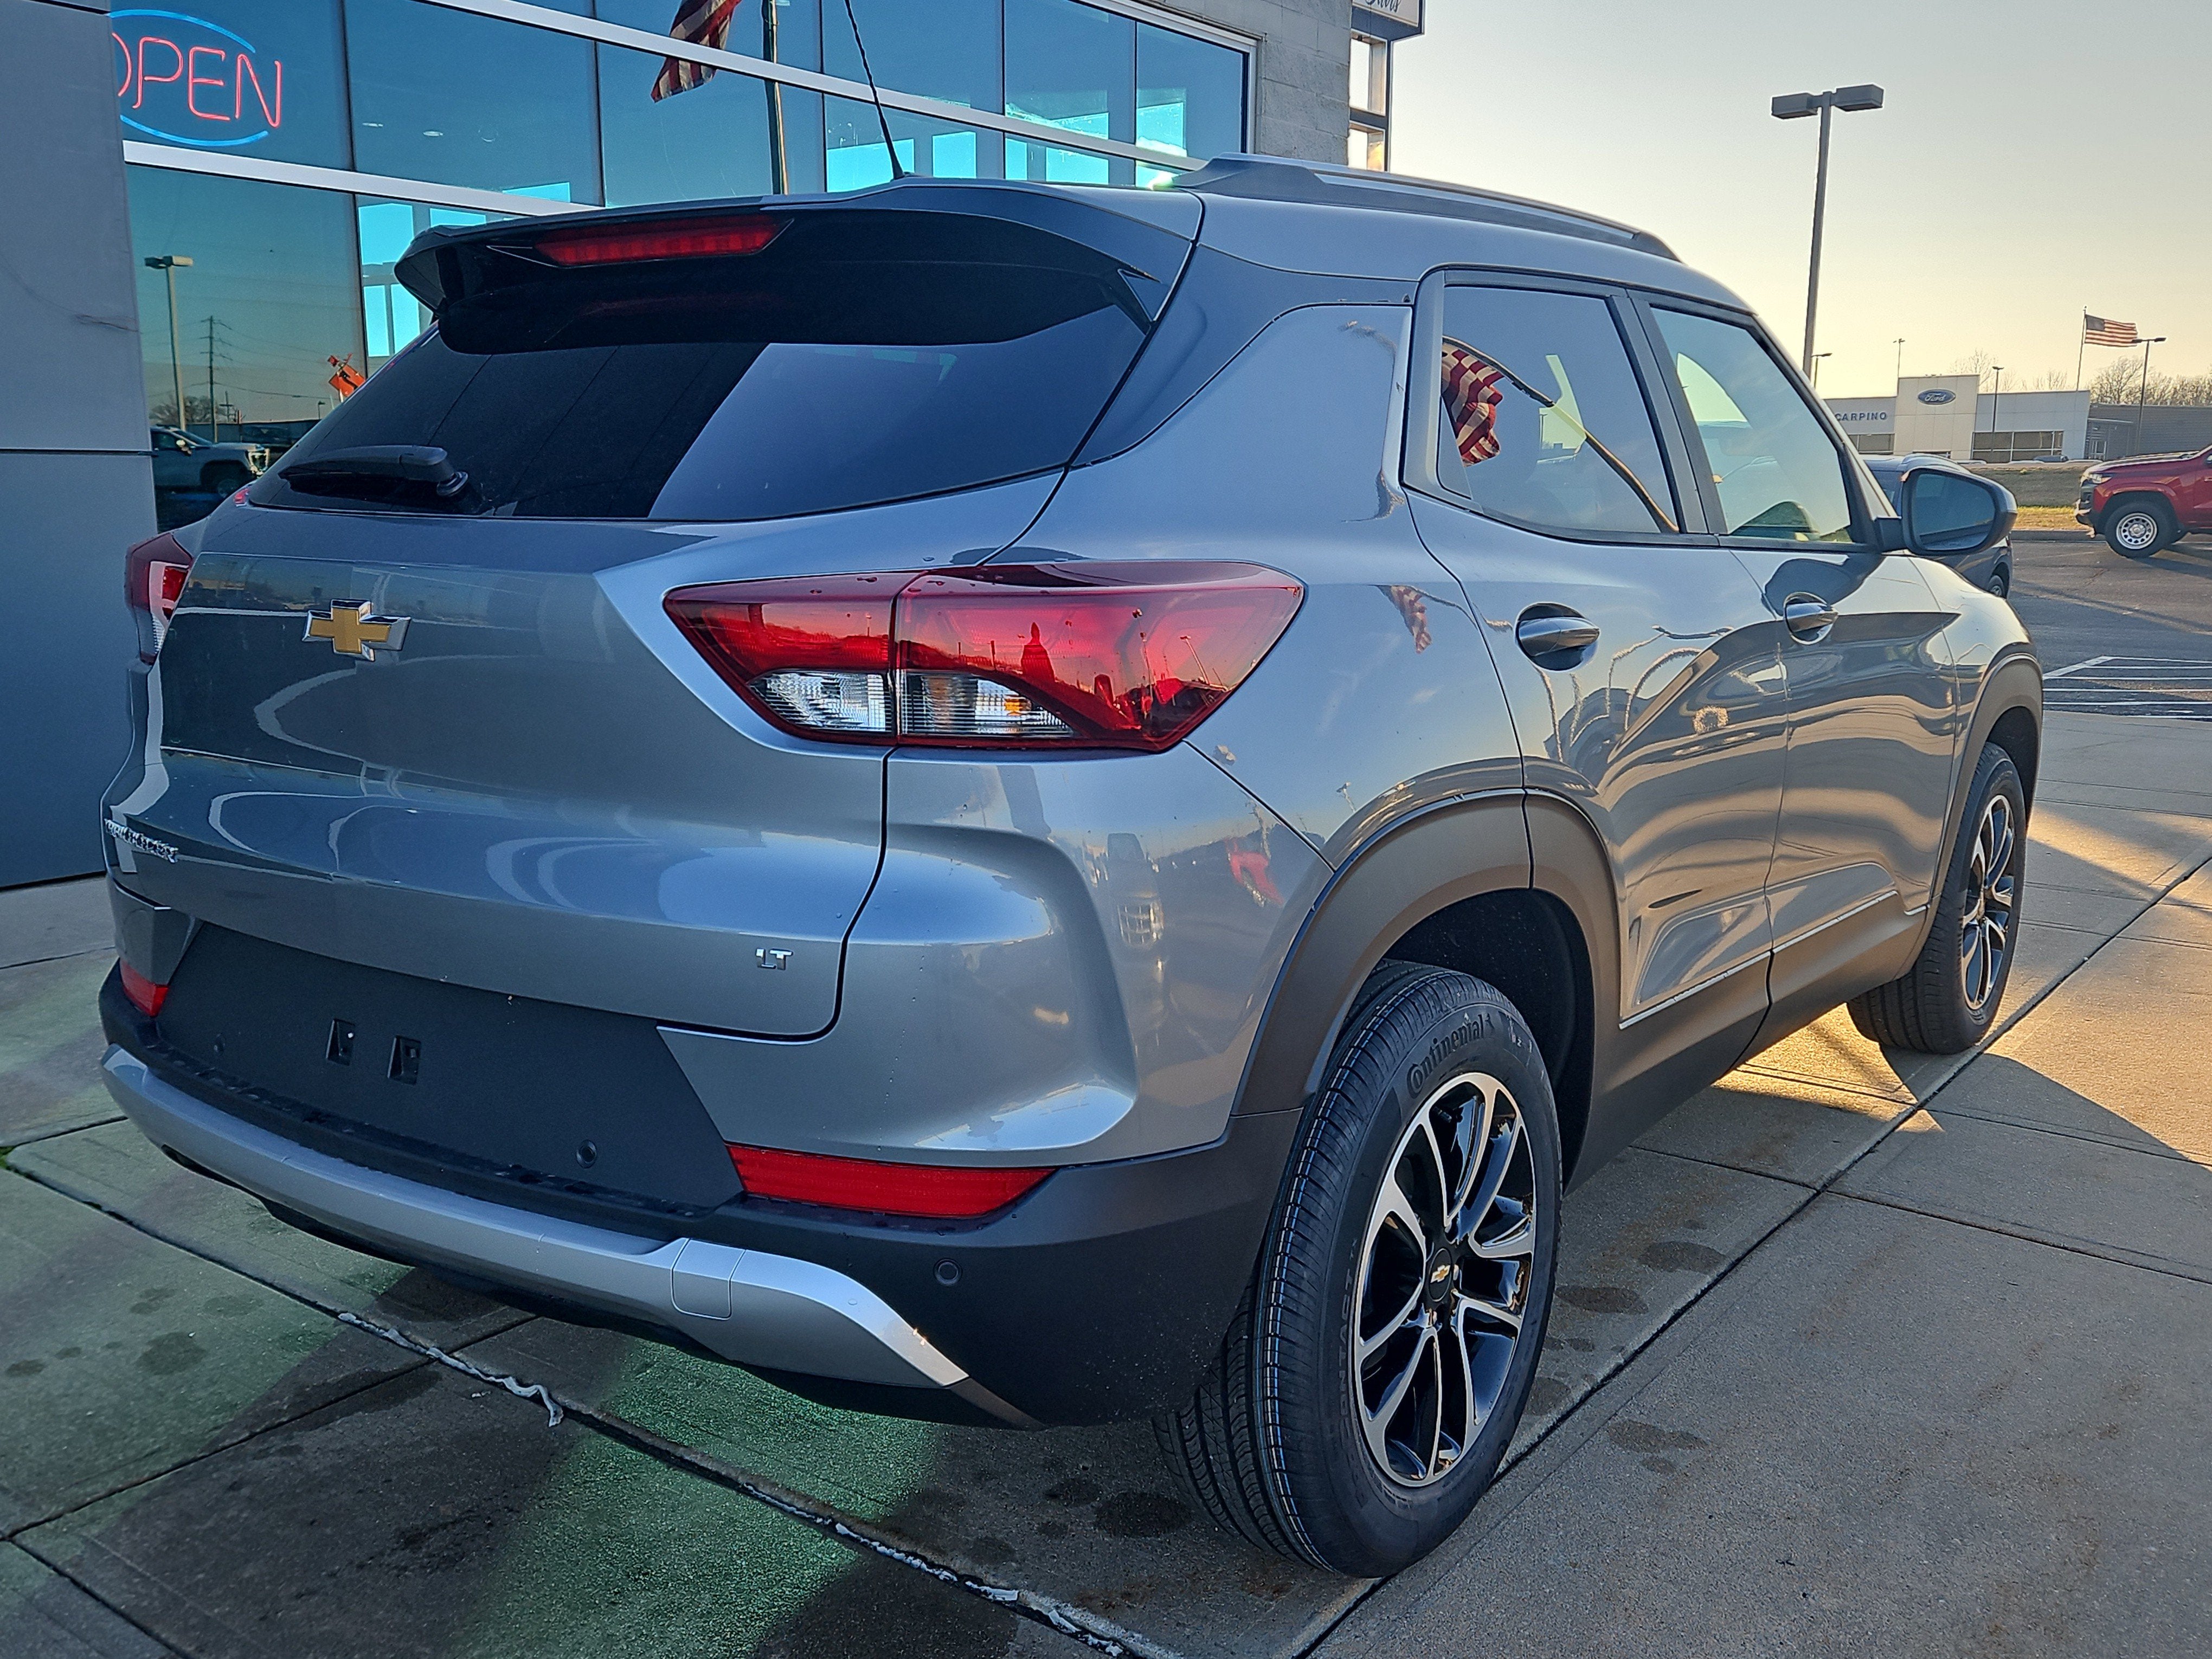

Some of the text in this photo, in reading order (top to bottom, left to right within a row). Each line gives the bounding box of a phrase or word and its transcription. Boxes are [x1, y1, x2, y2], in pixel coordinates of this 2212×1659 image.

[1835, 412, 1887, 421] CARPINO
[756, 948, 793, 970] LT
[1406, 1014, 1486, 1099] Continental
